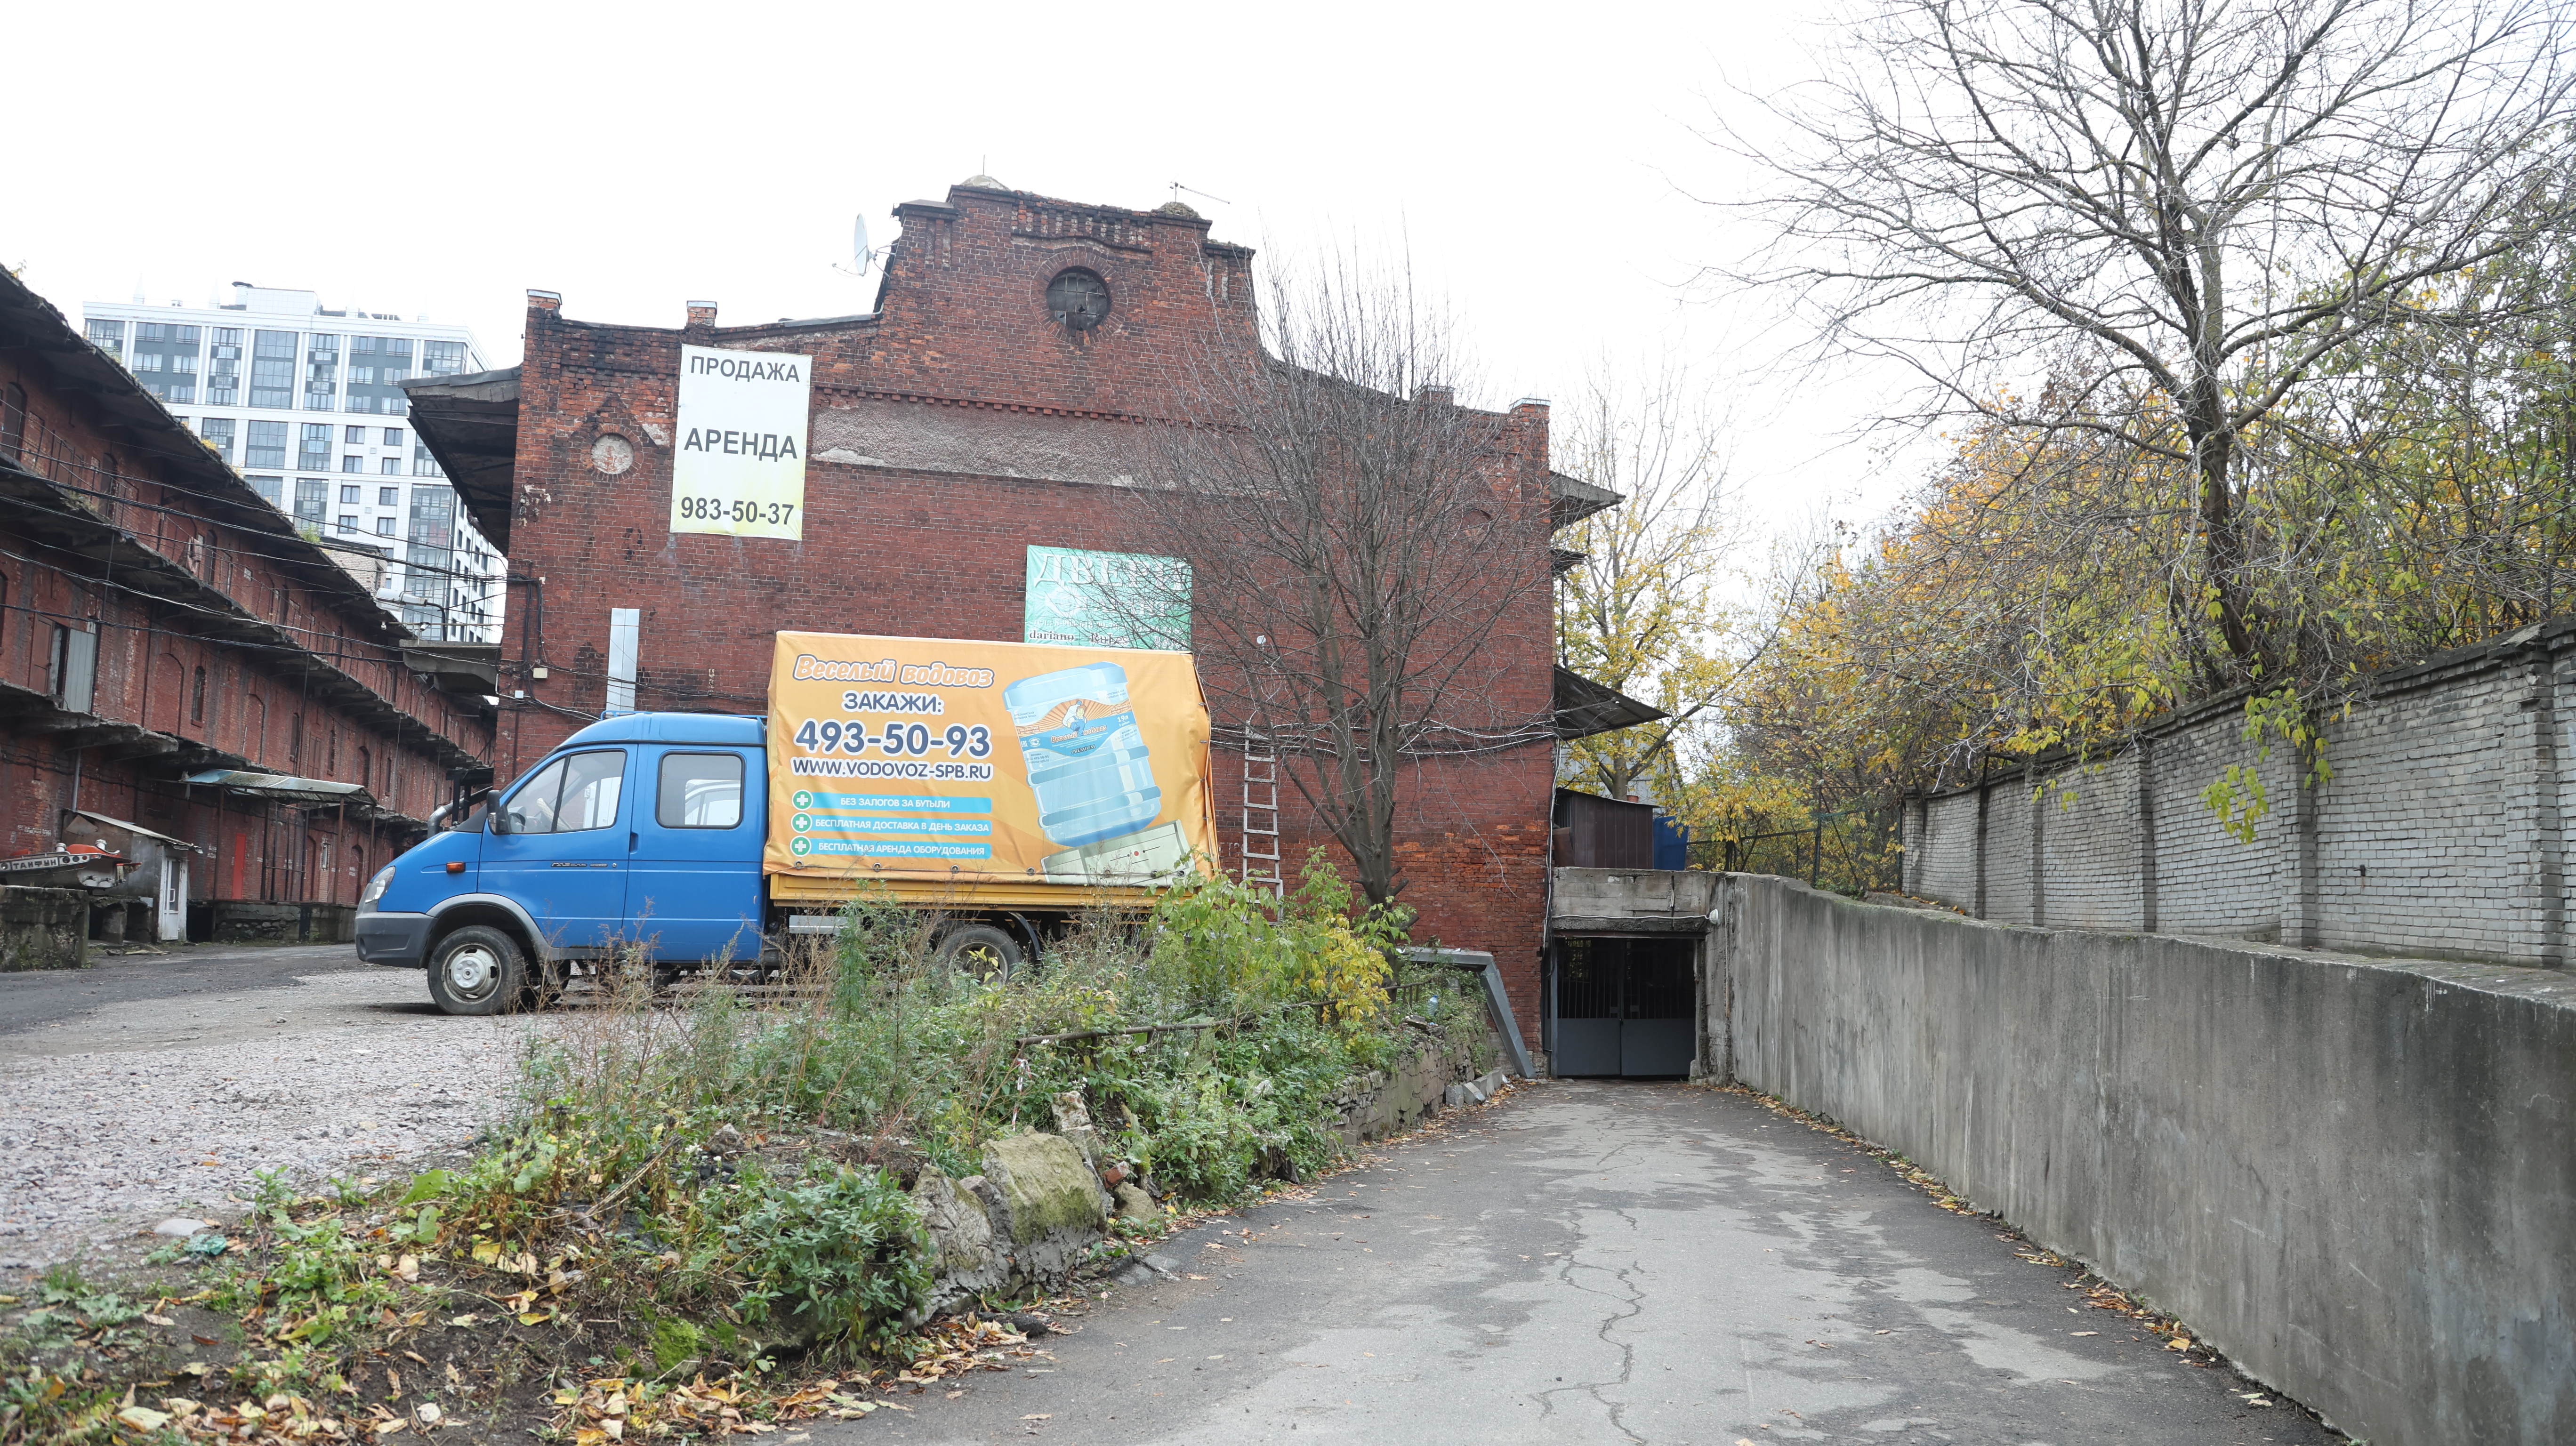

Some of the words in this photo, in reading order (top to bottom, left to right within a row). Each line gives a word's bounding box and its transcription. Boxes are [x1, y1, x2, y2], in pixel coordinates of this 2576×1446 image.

[691, 355, 800, 382] ПРОДАЖА
[684, 427, 797, 462] АРЕНДА
[681, 496, 794, 525] 983-50-37
[1033, 553, 1188, 590] ДВЕРИ
[1029, 629, 1074, 641] dariano
[794, 654, 896, 682] Веселый
[900, 662, 994, 687] водовоз
[844, 692, 942, 713] ЗАКАЖИ:
[796, 720, 990, 757] 493-50-93
[1051, 731, 1078, 743] Веселый
[1083, 725, 1107, 735] водовоз
[1071, 744, 1096, 755] PREMIUM
[793, 759, 991, 779] WWW.VODOVOZ-SPB.RU
[841, 797, 856, 805] БЕЗ
[859, 798, 899, 807] ЗАЛОГОВ
[902, 799, 914, 807] ЗА
[915, 799, 950, 809] БУТЫЛИ
[815, 819, 871, 829] БЕСПЛАТНАЯ
[873, 820, 919, 831] ДОСТАВКА
[921, 822, 927, 830] В
[929, 822, 952, 832] ДЕНЬ
[954, 823, 989, 832] ЗАКАЗА
[819, 843, 875, 853] БЕСПЛАТНАЯ
[876, 845, 911, 854] АРЕНДА
[913, 845, 984, 856] ОБОРУДОВАНИЯ
[13, 859, 56, 869] ТАЙФУН
